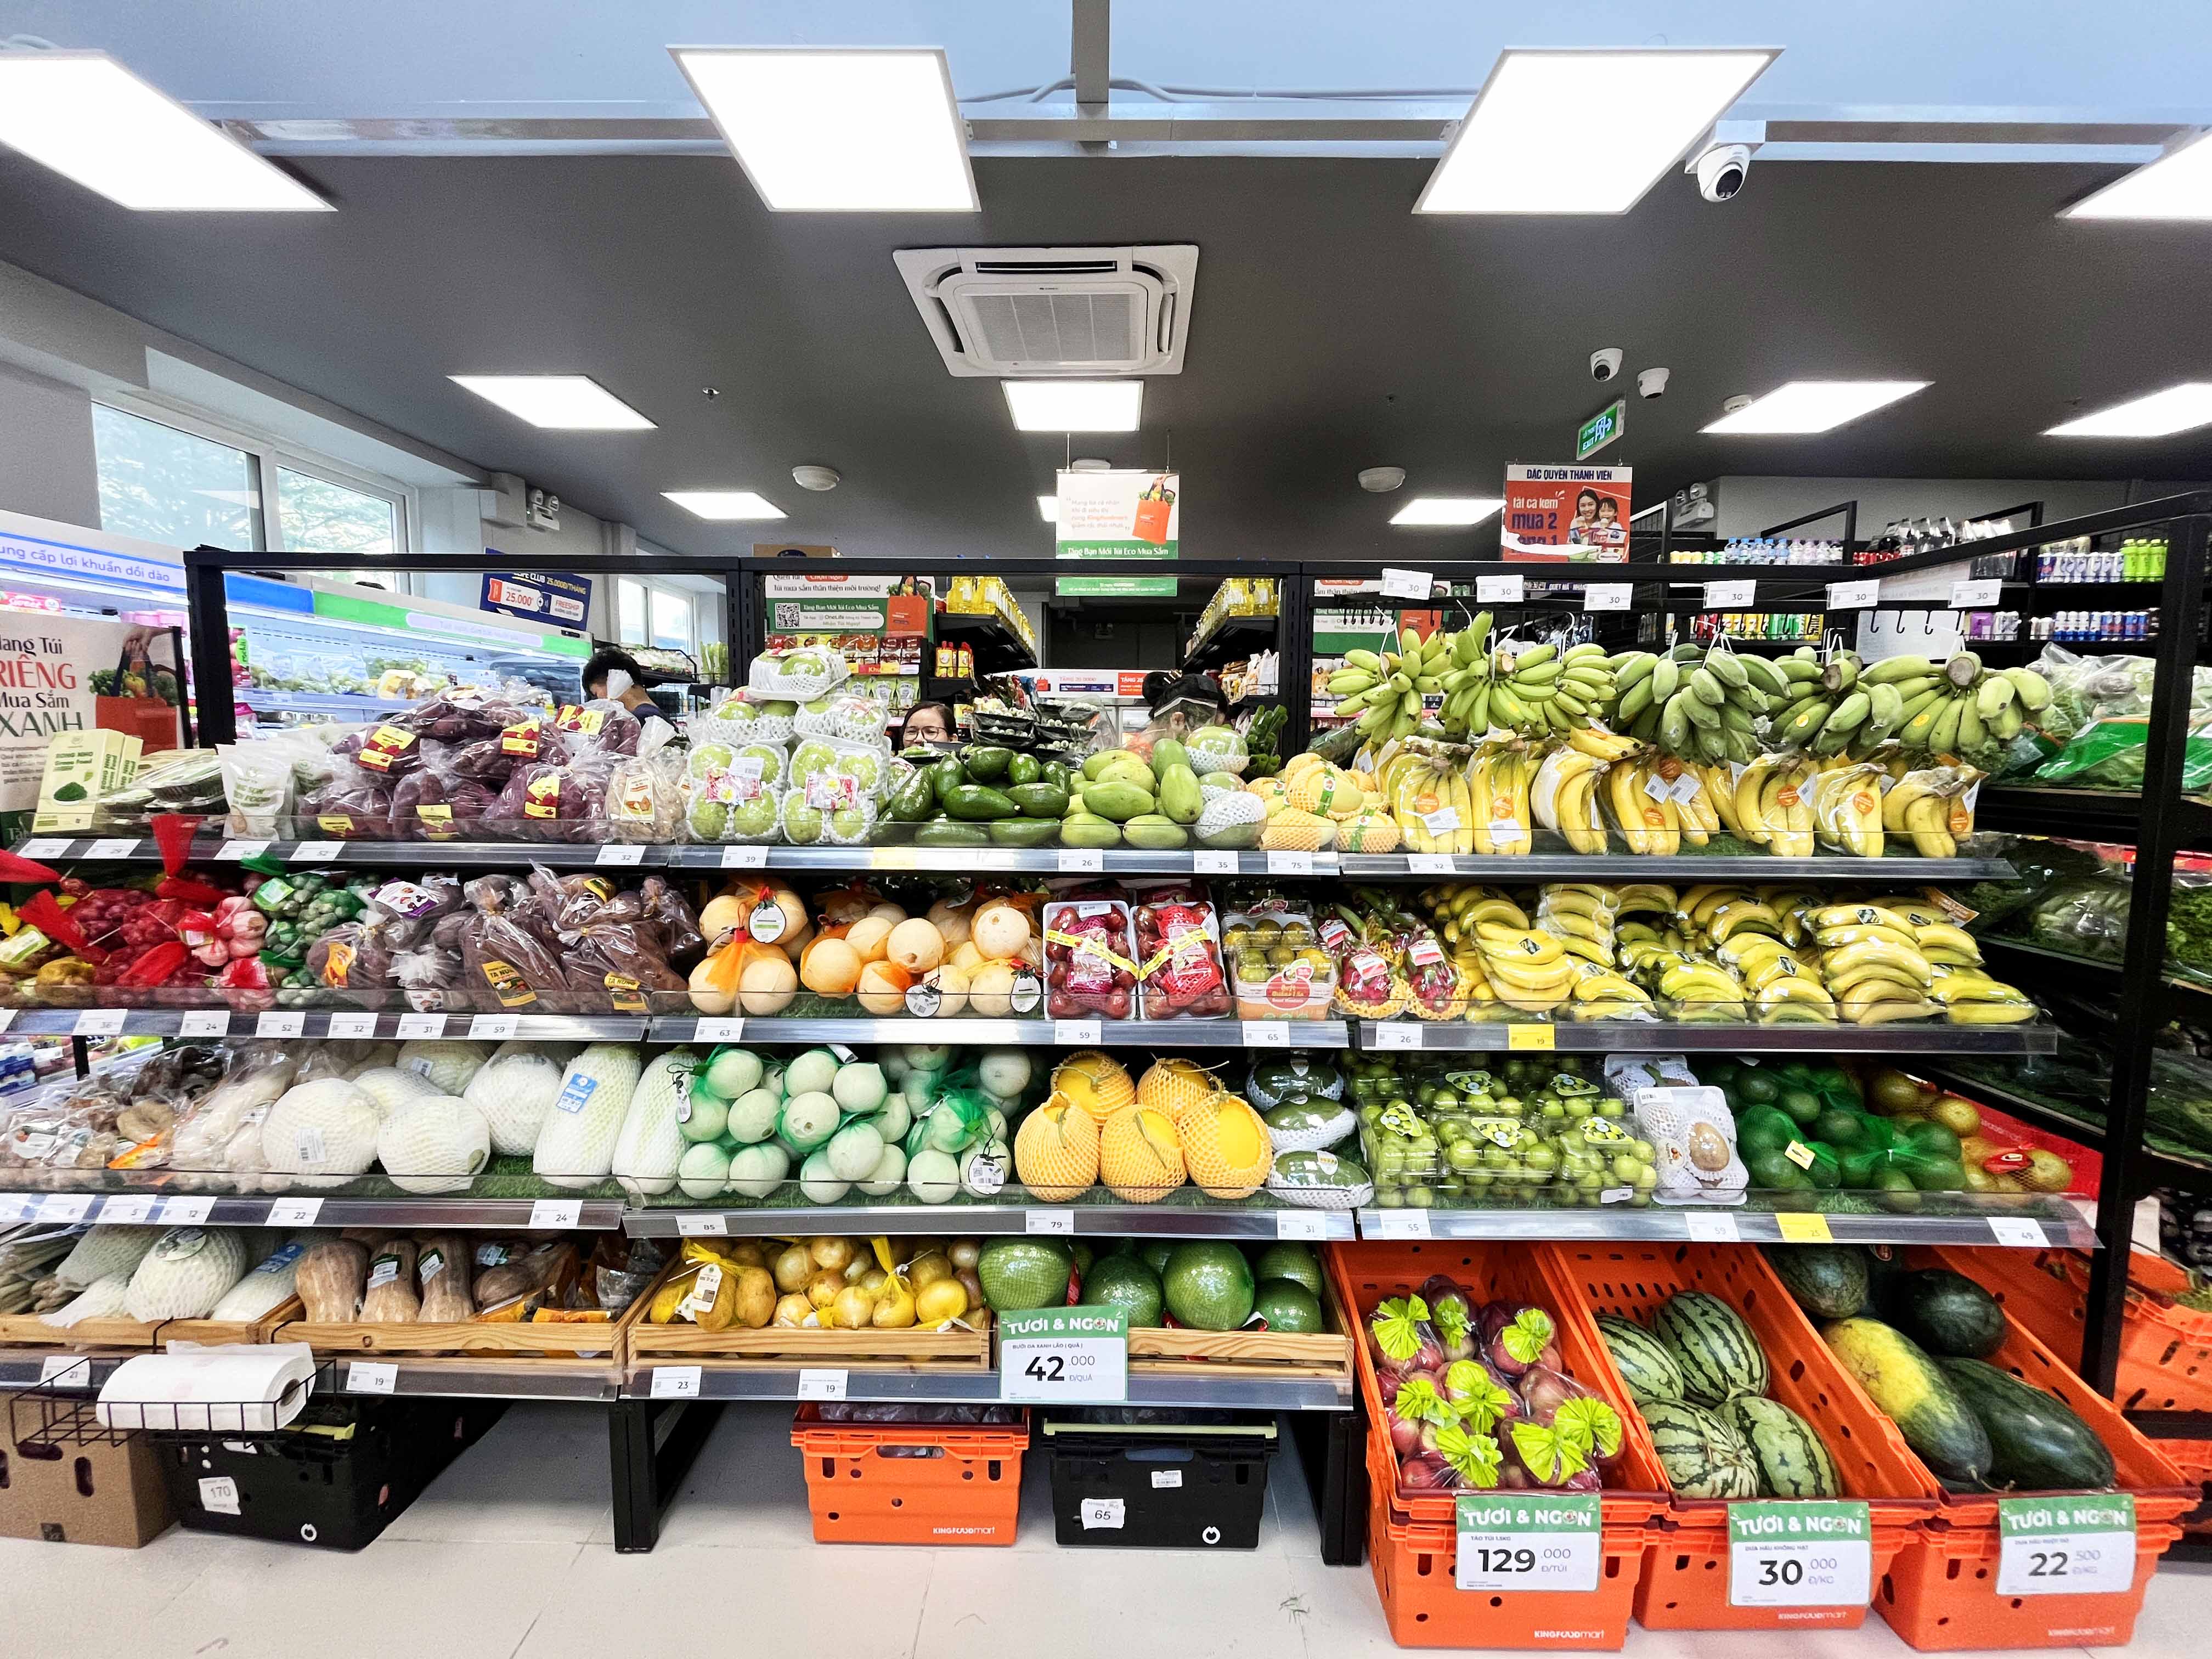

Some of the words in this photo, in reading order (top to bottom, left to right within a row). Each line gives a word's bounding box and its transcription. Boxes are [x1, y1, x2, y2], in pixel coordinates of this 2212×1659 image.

[1539, 498, 1558, 509] kem
[1512, 514, 1544, 529] mua
[1548, 512, 1558, 529] 2
[1084, 548, 1097, 556] Bạn
[0, 635, 36, 657] ang
[38, 637, 63, 654] Túi
[0, 654, 77, 690] RIÊNG
[36, 690, 70, 708] Sắm
[0, 711, 83, 737] XANH
[1007, 1318, 1048, 1334] TƯƠI
[1053, 1318, 1065, 1330] &
[1025, 1356, 1064, 1381] 42
[1069, 1356, 1095, 1365] .000
[210, 1485, 231, 1498] 170
[1095, 1510, 1110, 1520] 65
[1464, 1508, 1511, 1526] TƯƠI
[1516, 1509, 1530, 1524] &
[1737, 1515, 1783, 1536] TƯƠI
[1788, 1516, 1801, 1532] &
[2007, 1509, 2052, 1530] TƯƠI
[2057, 1510, 2070, 1525] &
[1478, 1549, 1536, 1572] 129
[1541, 1548, 1571, 1559] .000
[2028, 1552, 2068, 1576] 22
[1758, 1559, 1803, 1585] 30
[1808, 1558, 1837, 1570] .000
